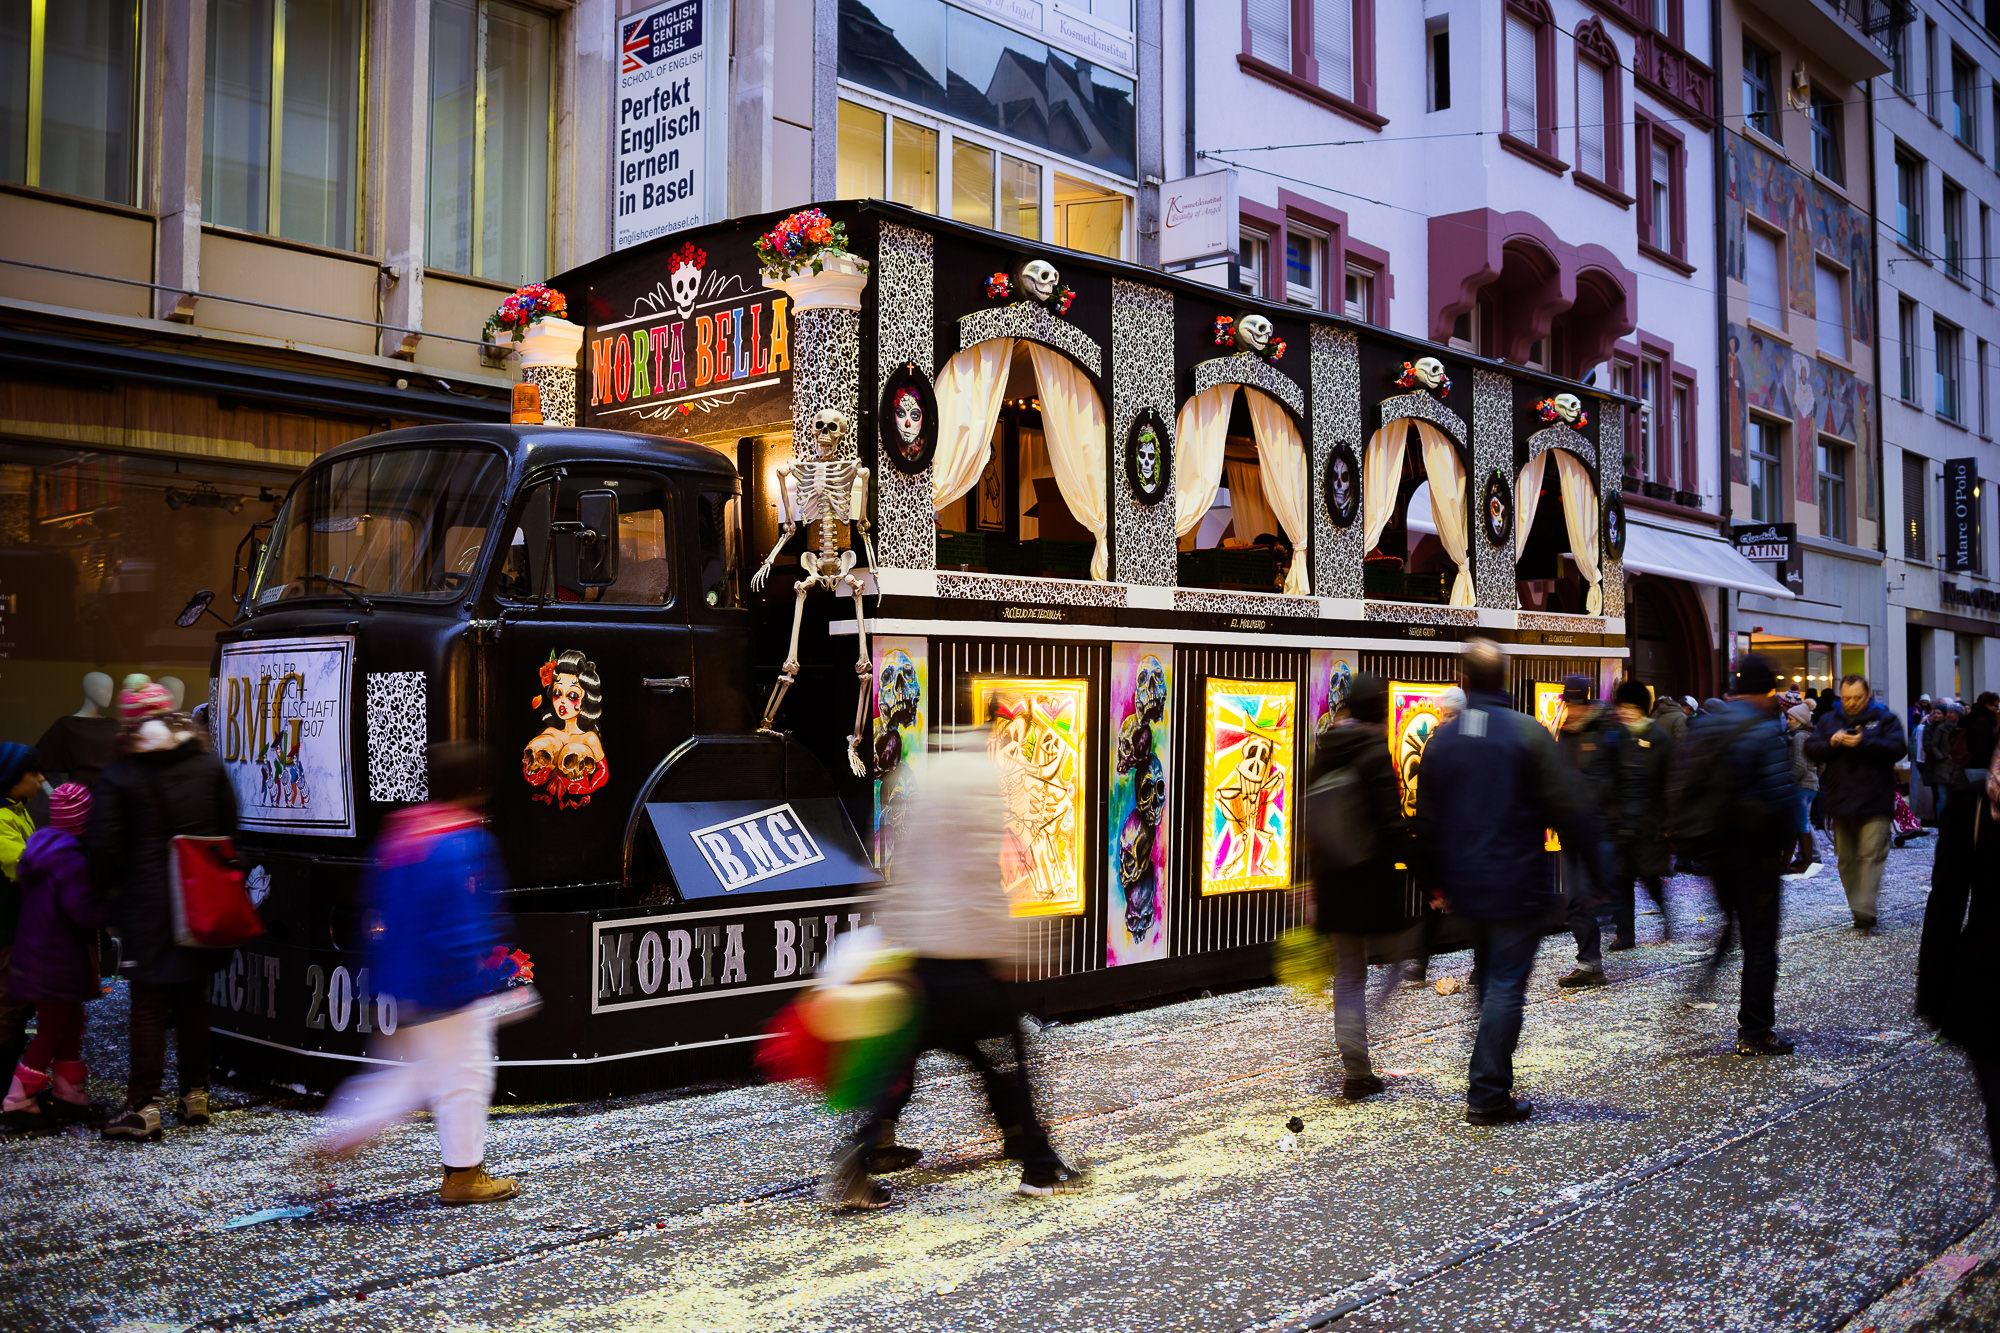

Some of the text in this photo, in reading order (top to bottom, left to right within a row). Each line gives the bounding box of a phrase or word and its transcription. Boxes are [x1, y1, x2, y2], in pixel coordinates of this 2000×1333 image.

[653, 3, 697, 30] ENGLISH
[653, 19, 693, 44] CENTER
[653, 36, 686, 58] BASEL
[1060, 19, 1127, 61] Kosmetikinstitut
[622, 51, 703, 89] SCHOOL OF ENGLISH
[621, 77, 690, 125] Perfekt
[621, 106, 700, 155] Englisch
[620, 149, 679, 186] lernen
[619, 169, 694, 217] in Basel
[618, 214, 700, 245] englishcenterbasel.ch
[591, 297, 790, 407] MORTA BELLA
[1955, 464, 1968, 566] Marc O'Polo
[1740, 545, 1785, 557] LATINI
[260, 663, 296, 680] BASLER
[260, 700, 337, 719] GESELLSCHAFT
[700, 812, 812, 884] BMG
[599, 923, 747, 998] MORTA
[306, 964, 398, 1036] 2016
